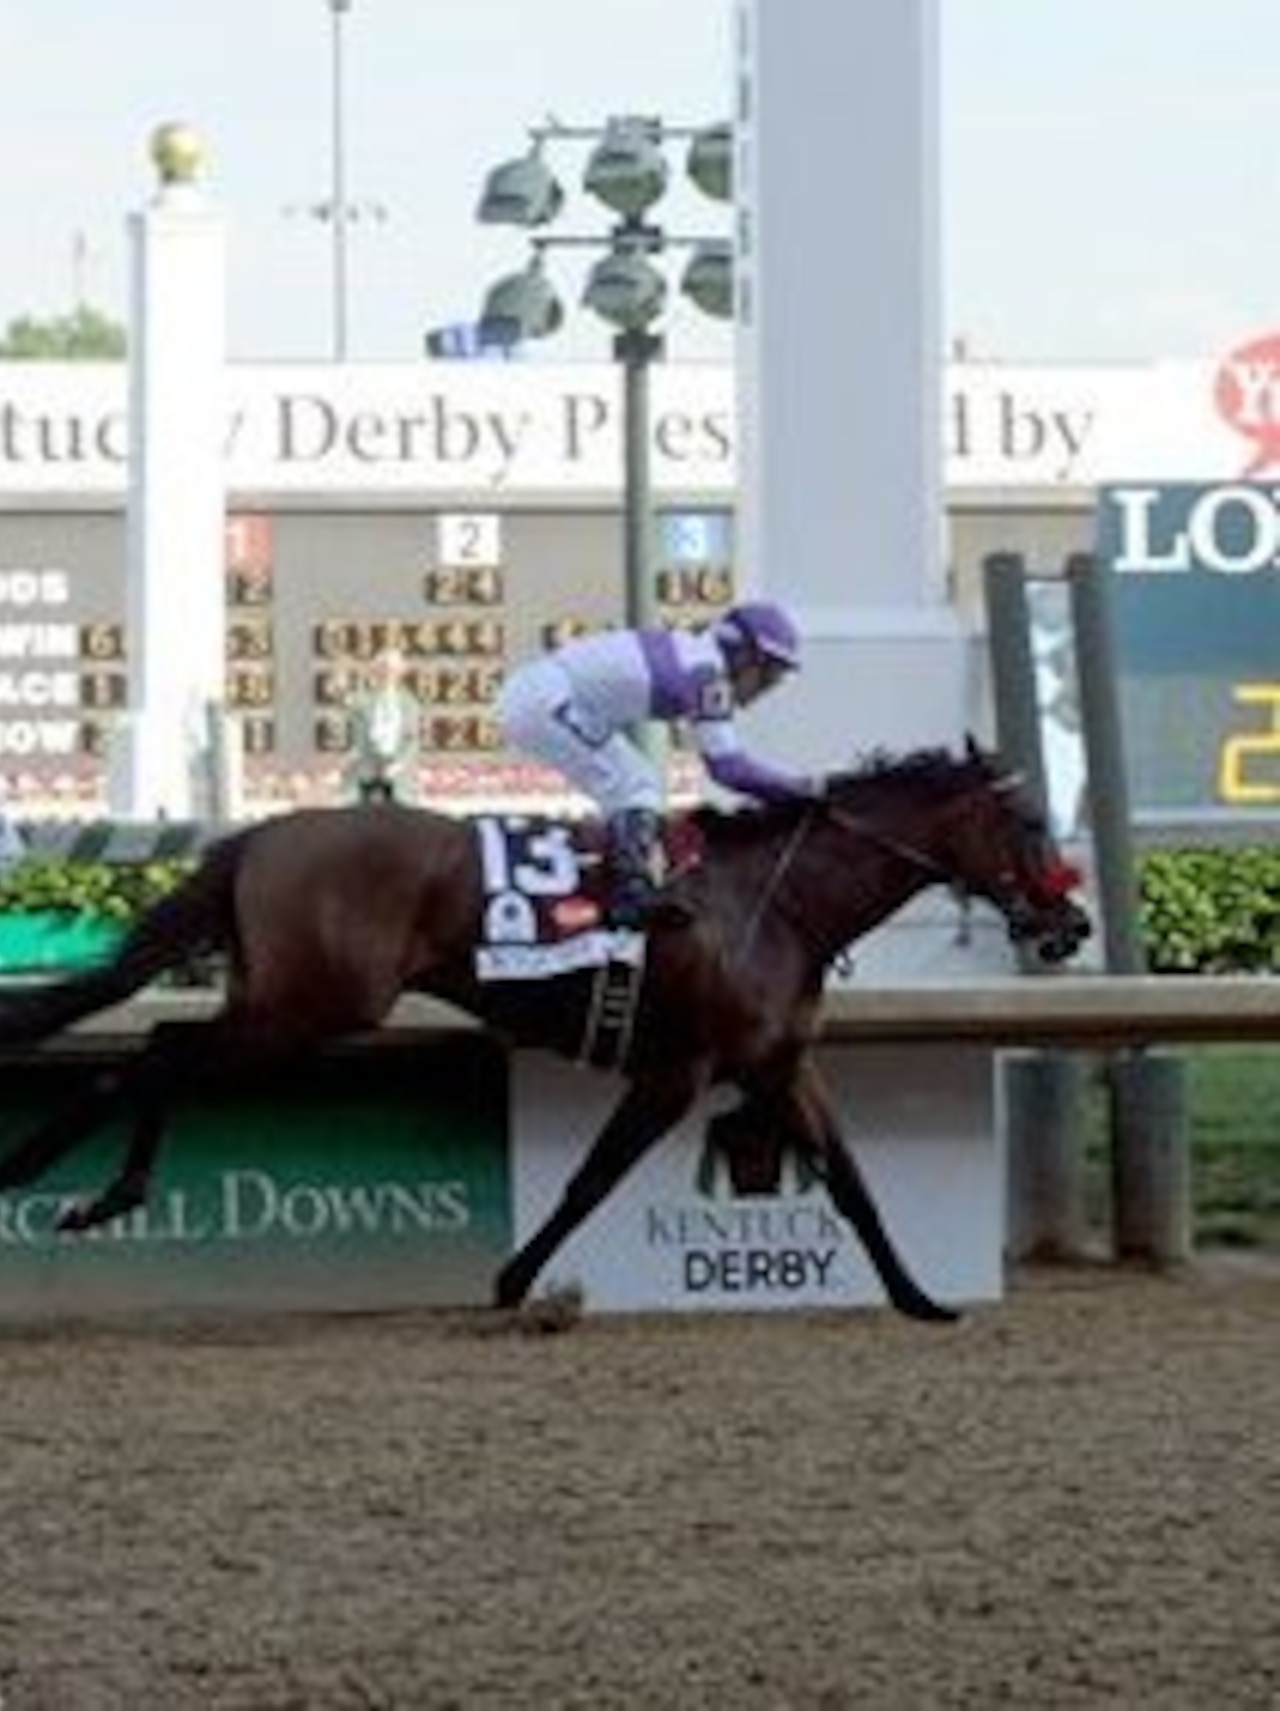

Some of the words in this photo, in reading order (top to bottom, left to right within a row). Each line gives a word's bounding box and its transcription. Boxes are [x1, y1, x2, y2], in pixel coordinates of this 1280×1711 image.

[274, 394, 531, 488] Derby
[1000, 389, 1094, 481] by
[460, 521, 480, 559] 2
[1111, 486, 1280, 573] LO
[476, 817, 579, 896] 13
[685, 1250, 837, 1293] DERBY
